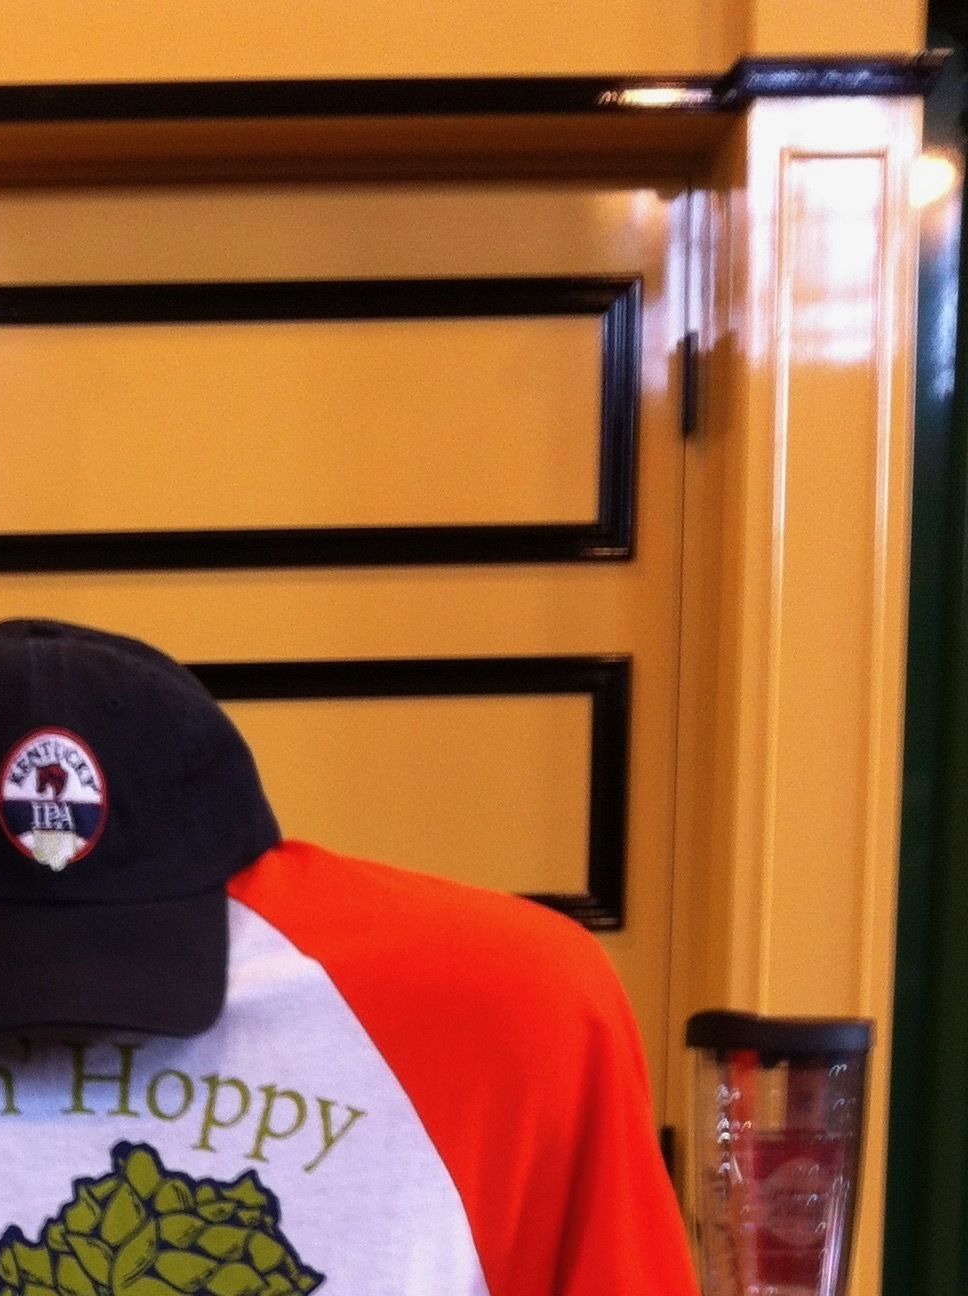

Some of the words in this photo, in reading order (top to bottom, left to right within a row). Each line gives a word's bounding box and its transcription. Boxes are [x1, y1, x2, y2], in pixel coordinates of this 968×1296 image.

[11, 741, 100, 791] KENTUCKY
[32, 801, 75, 830] IPA
[62, 1038, 368, 1172] Hoppy
